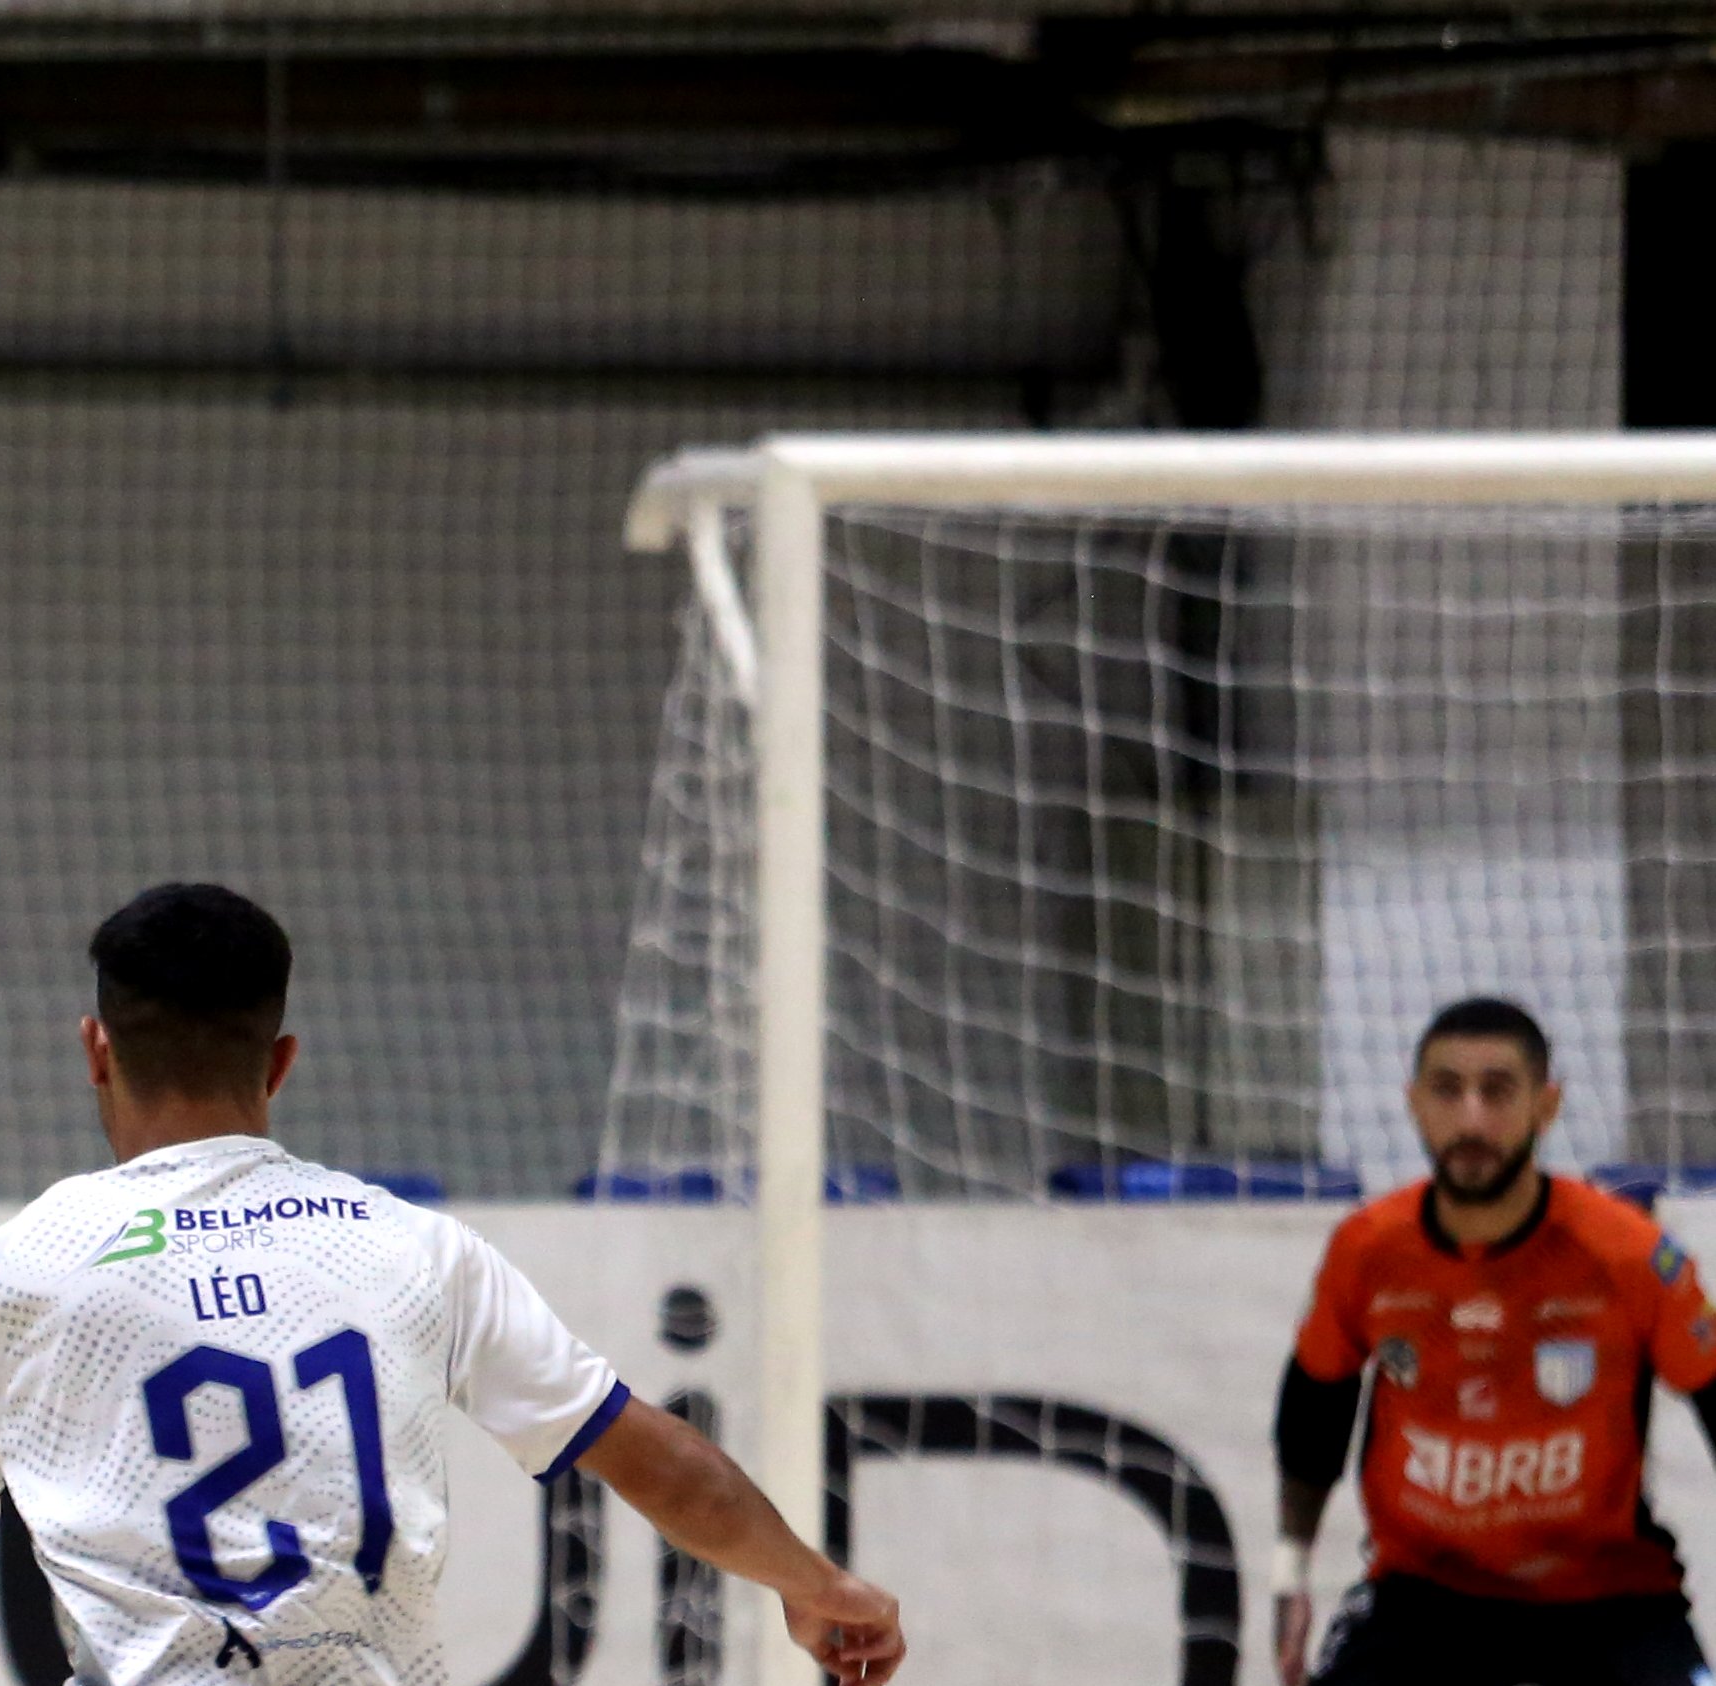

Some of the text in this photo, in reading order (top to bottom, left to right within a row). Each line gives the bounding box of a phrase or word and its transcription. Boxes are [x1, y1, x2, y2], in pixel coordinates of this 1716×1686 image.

[171, 1225, 275, 1255] SPORTS
[174, 1196, 372, 1232] BELMONTE
[189, 1266, 268, 1322] LÉO
[142, 1325, 396, 1612] 21
[1451, 1431, 1586, 1507] BRB
